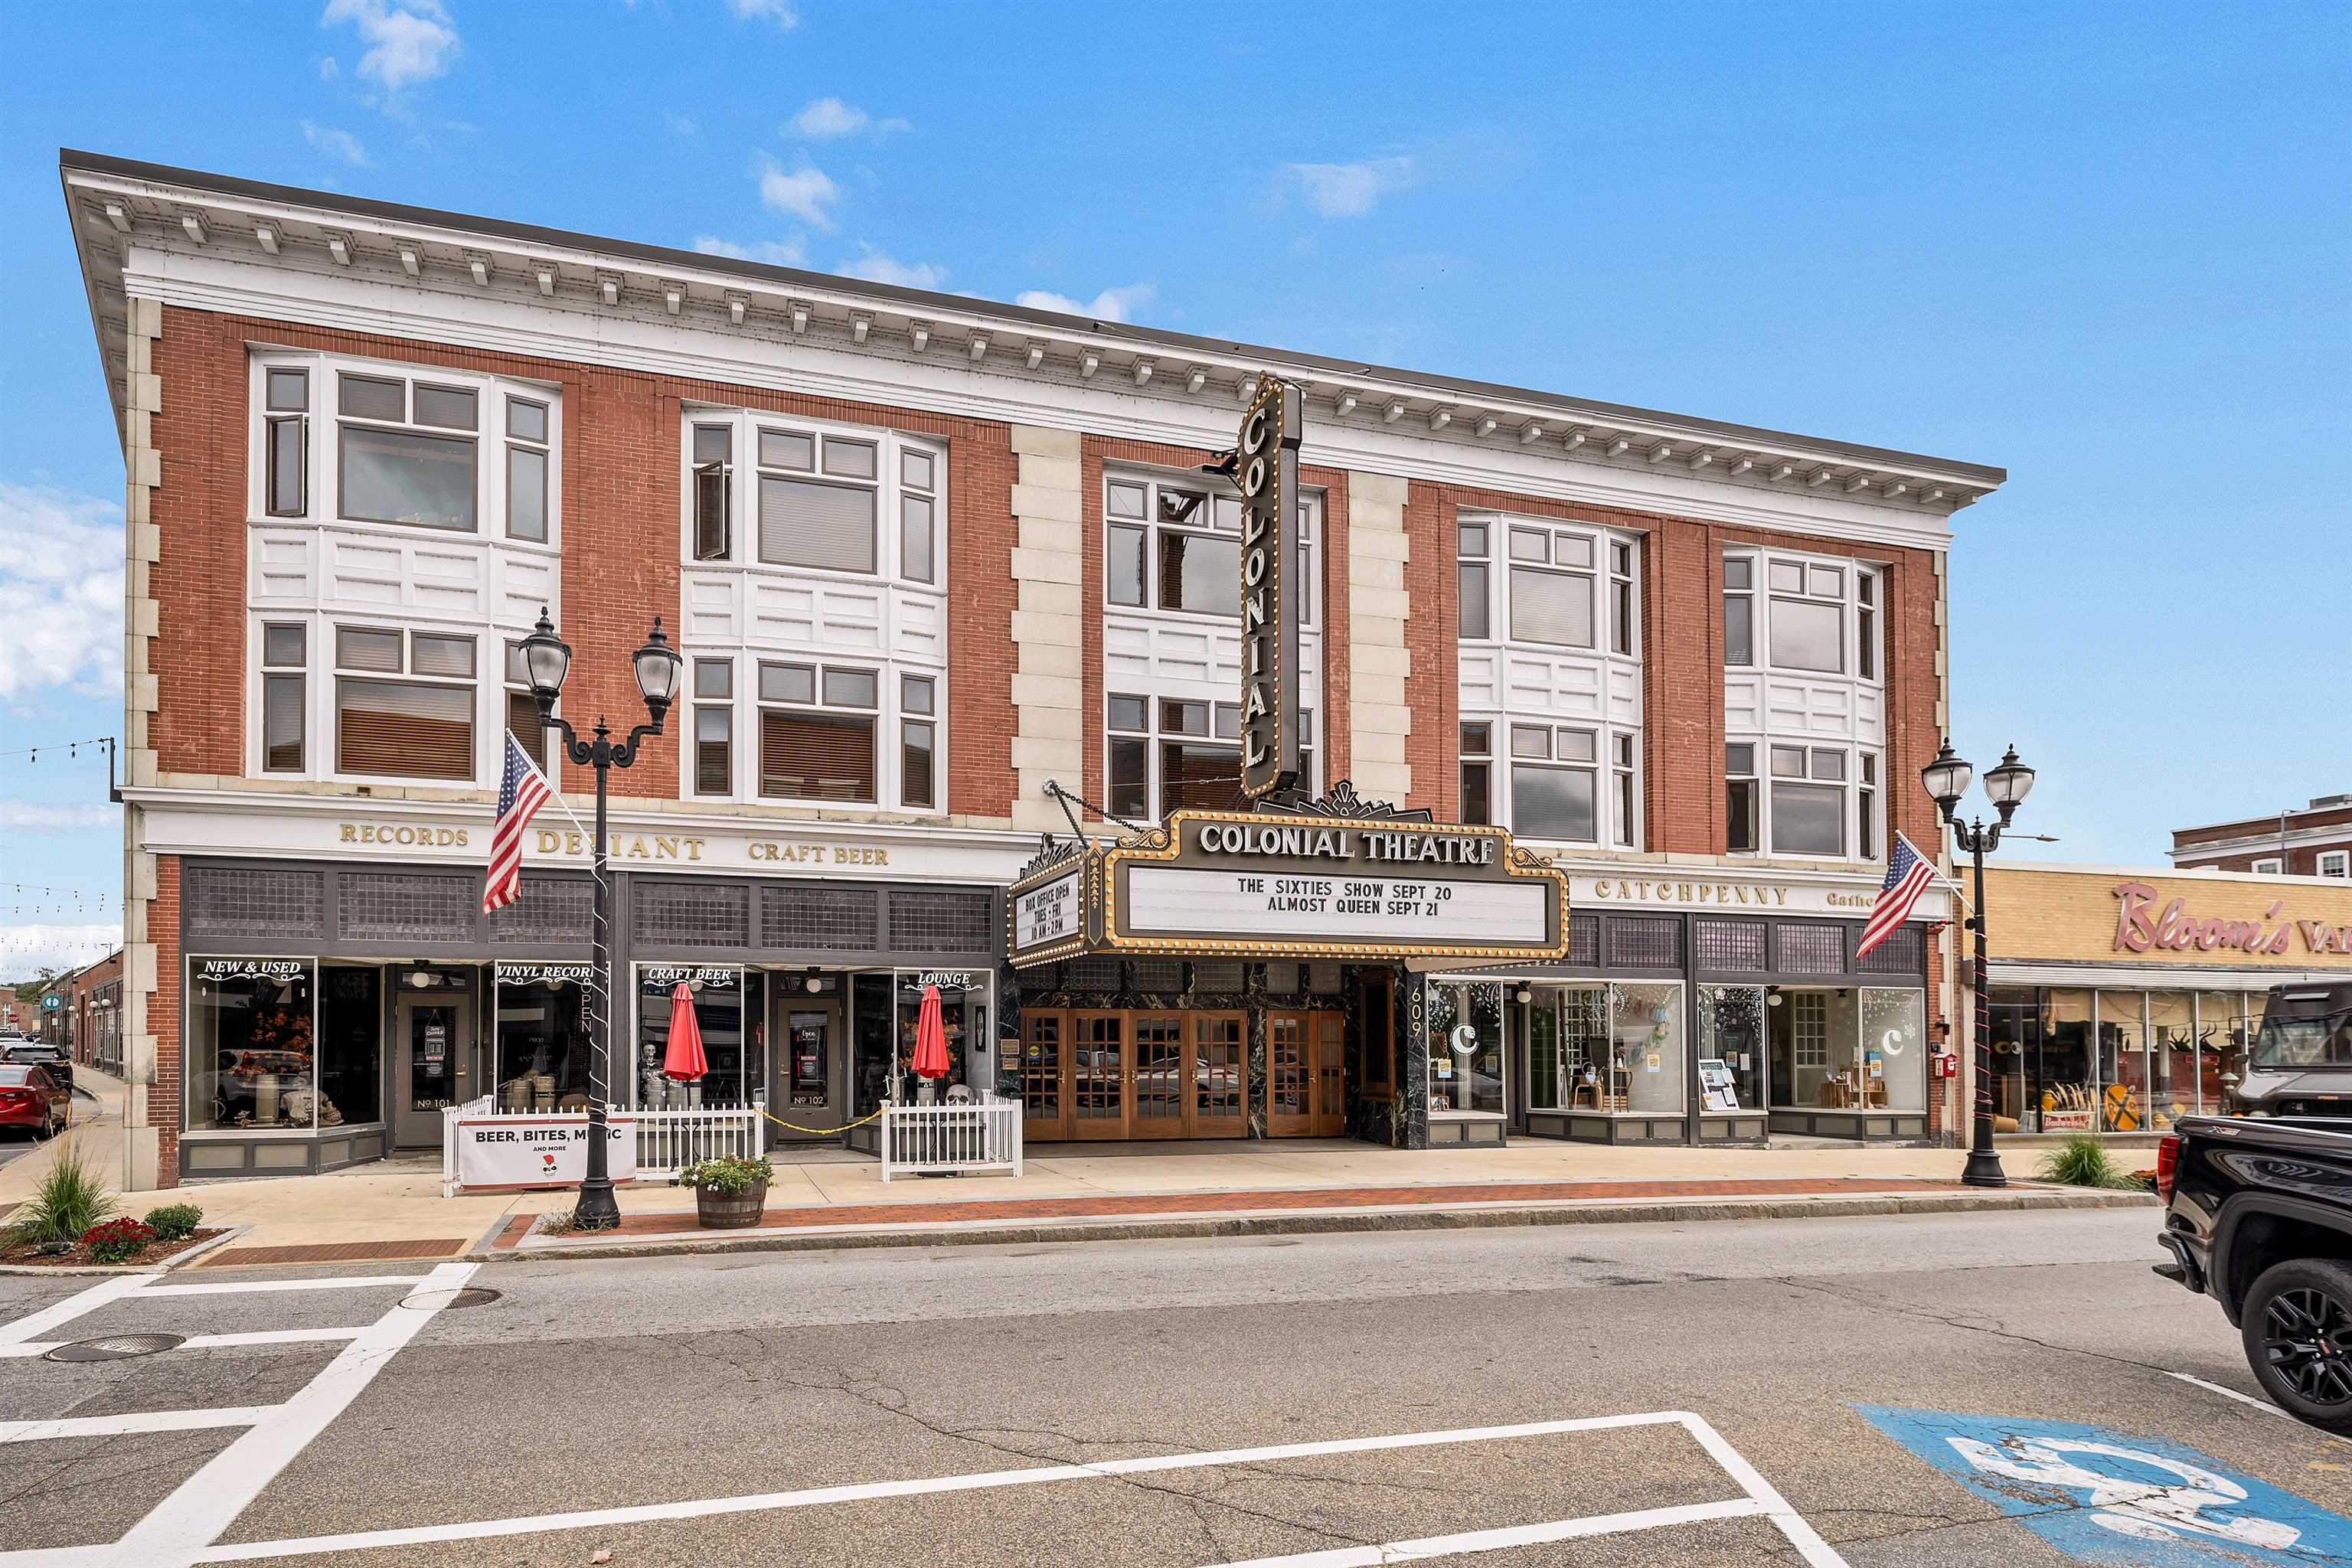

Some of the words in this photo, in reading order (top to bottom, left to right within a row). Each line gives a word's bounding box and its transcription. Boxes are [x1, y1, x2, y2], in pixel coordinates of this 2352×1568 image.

[1243, 408, 1270, 769] COLONIAL
[339, 823, 469, 846] RECORDS
[537, 830, 705, 860] DEIANT
[1199, 823, 1355, 859] COLONIAL
[1361, 831, 1495, 865] THEATRE
[748, 842, 827, 863] CRAFT
[834, 845, 889, 866] BEER
[1025, 895, 1036, 912] BOX
[1037, 889, 1054, 907] OFFICE
[1055, 881, 1070, 900] OPEN
[1237, 877, 1264, 893] THE
[1276, 880, 1332, 896] SIXTIES
[1344, 883, 1384, 898] SHOW
[1393, 885, 1426, 900] SEPT
[1435, 887, 1452, 900] 20
[1596, 880, 1788, 906] CATCHPENNY
[1827, 893, 1874, 907] Gathe
[1034, 908, 1047, 924] TUES
[1052, 902, 1061, 919] FRI
[1268, 897, 1327, 913] ALMOST
[1336, 900, 1380, 914] QUEEN
[1387, 902, 1420, 916] SEPT
[1426, 903, 1439, 916] 21
[2112, 880, 2292, 953] Bloom's
[1031, 926, 1037, 940] 10
[1038, 922, 1047, 938] AM
[204, 961, 243, 972] NEW
[244, 961, 257, 973] &
[260, 962, 301, 973] USED
[498, 965, 539, 977] VINYL
[648, 968, 693, 979] CRAFT
[696, 969, 731, 980] BEER
[918, 973, 971, 984] LOUNGE
[580, 984, 593, 1033] OPEN
[1412, 987, 1422, 1037] 609
[802, 1029, 816, 1038] Open
[434, 1099, 449, 1108] 101
[808, 1096, 824, 1105] 102
[475, 1131, 519, 1144] BEER,
[523, 1129, 570, 1143] BITES,
[574, 1128, 622, 1140] MIC
